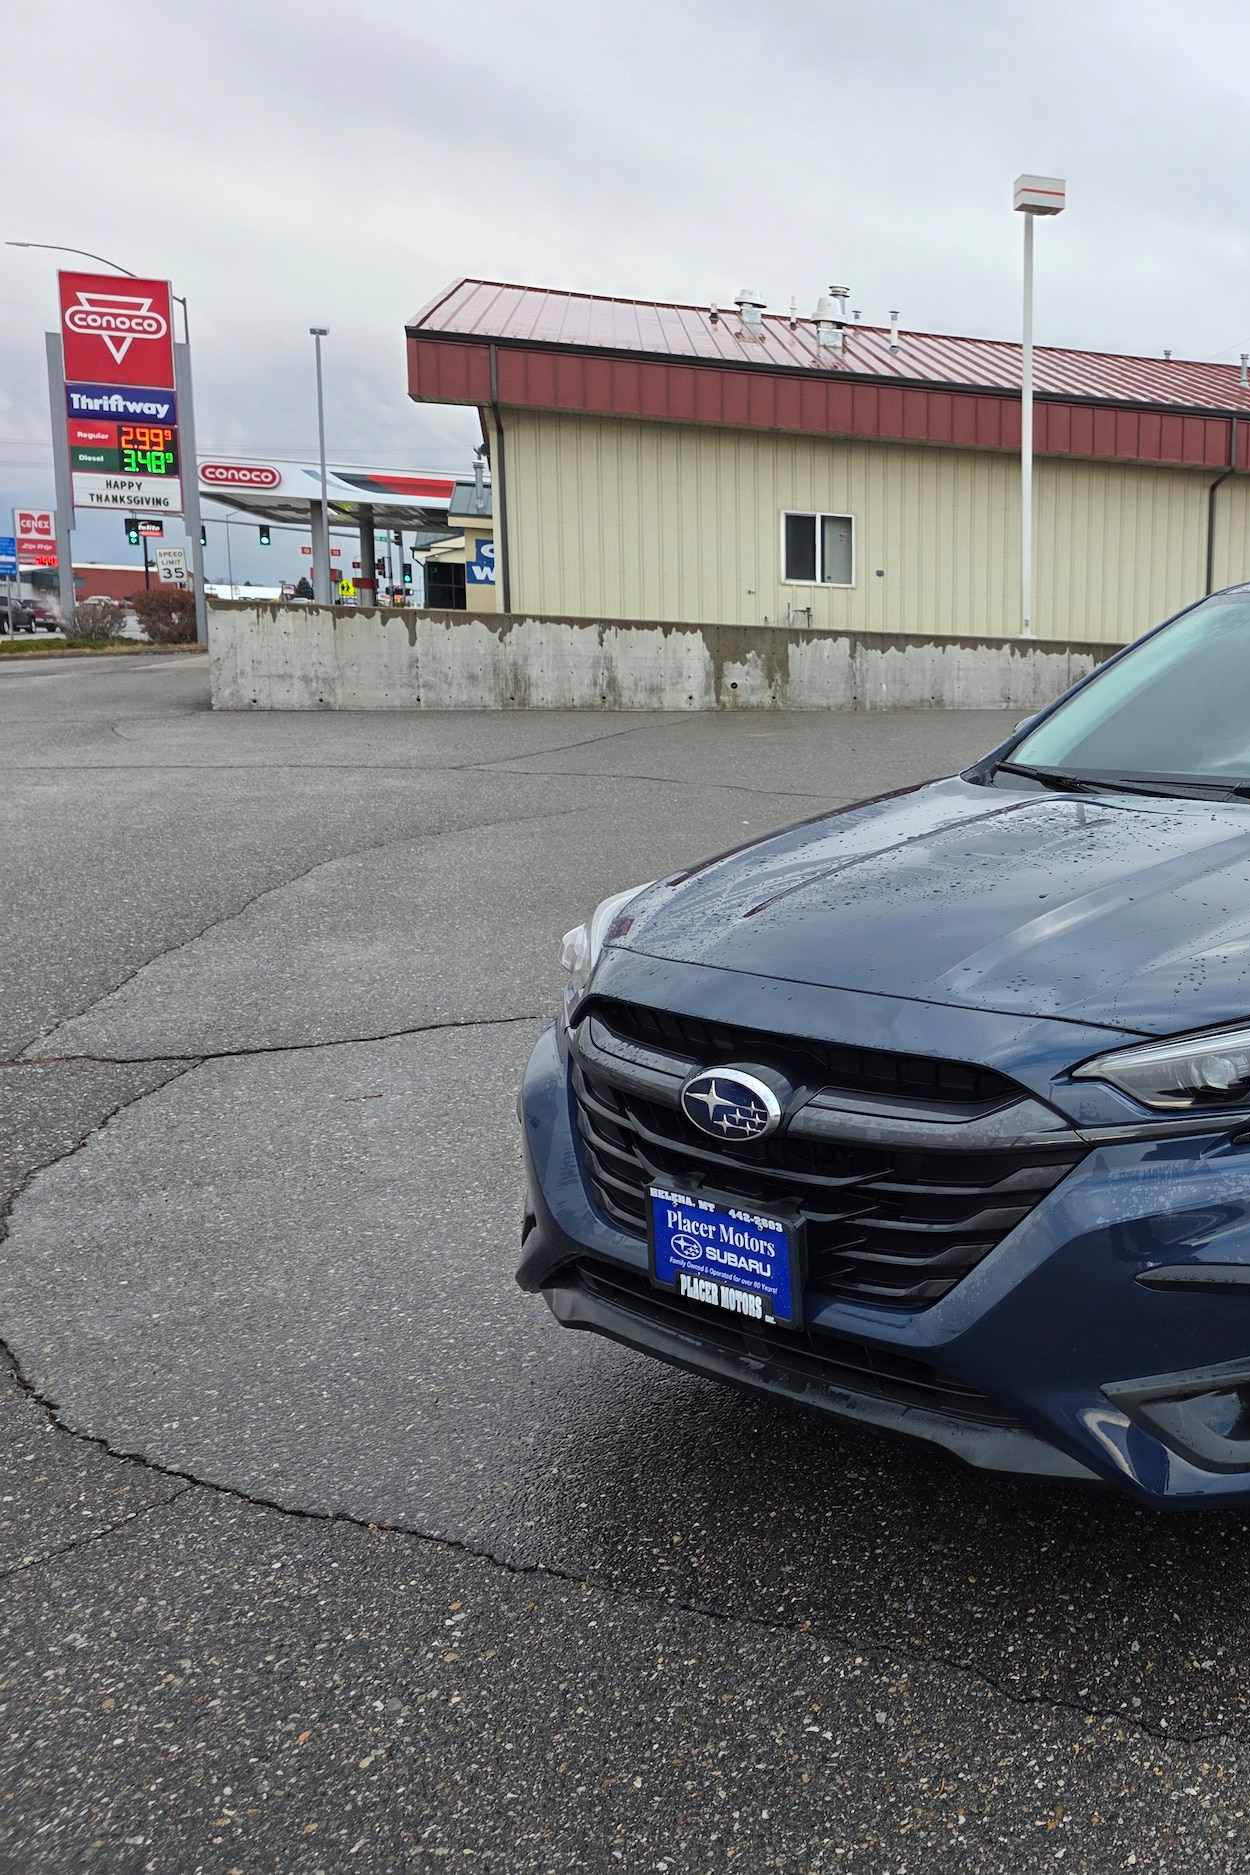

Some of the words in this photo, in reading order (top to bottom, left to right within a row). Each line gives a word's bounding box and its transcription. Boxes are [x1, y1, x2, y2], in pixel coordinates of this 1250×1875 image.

[70, 393, 170, 419] Thriftway
[77, 431, 109, 440] Regular
[78, 454, 104, 462] Diesel
[106, 480, 143, 491] HAPPY
[89, 493, 170, 507] THANKSGIVING
[20, 519, 50, 529] CENEX
[162, 567, 185, 579] 35
[666, 1209, 717, 1240] Placer
[719, 1223, 776, 1258] Motors
[705, 1246, 772, 1278] SUBARU
[669, 1256, 687, 1268] Family
[686, 1260, 704, 1273] Owned
[709, 1267, 733, 1281] Operated
[732, 1274, 741, 1283] for
[741, 1278, 753, 1287] over
[680, 1273, 719, 1306] PLACER
[720, 1285, 763, 1320] MOTORS
